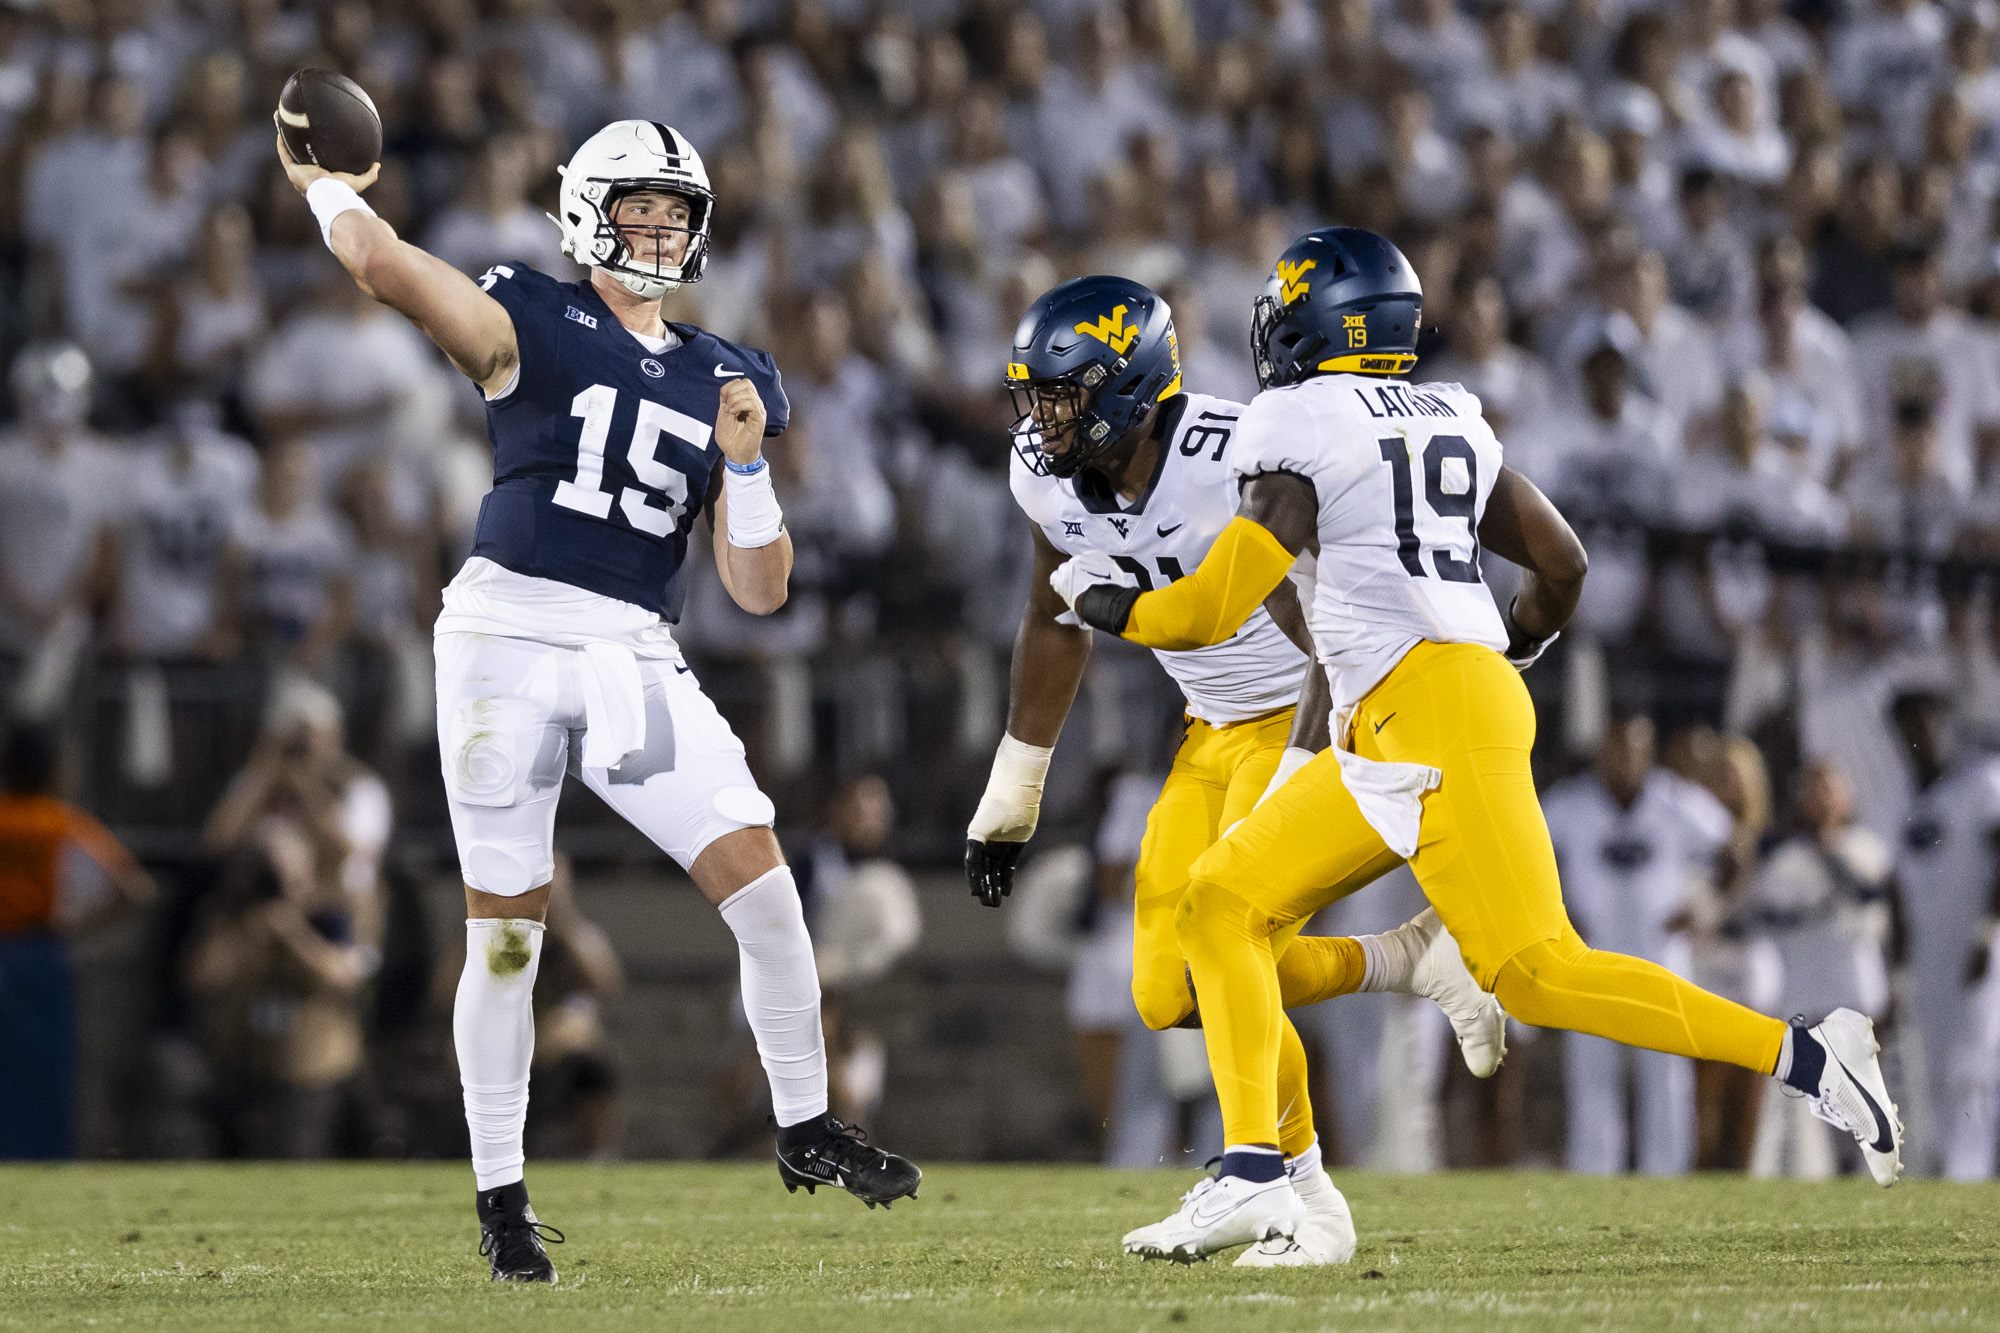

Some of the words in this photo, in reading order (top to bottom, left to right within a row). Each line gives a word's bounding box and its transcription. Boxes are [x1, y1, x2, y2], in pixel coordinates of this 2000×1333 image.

[1348, 329, 1367, 348] 19
[551, 383, 713, 538] 15
[1179, 410, 1240, 462] 91
[1378, 434, 1483, 583] 19
